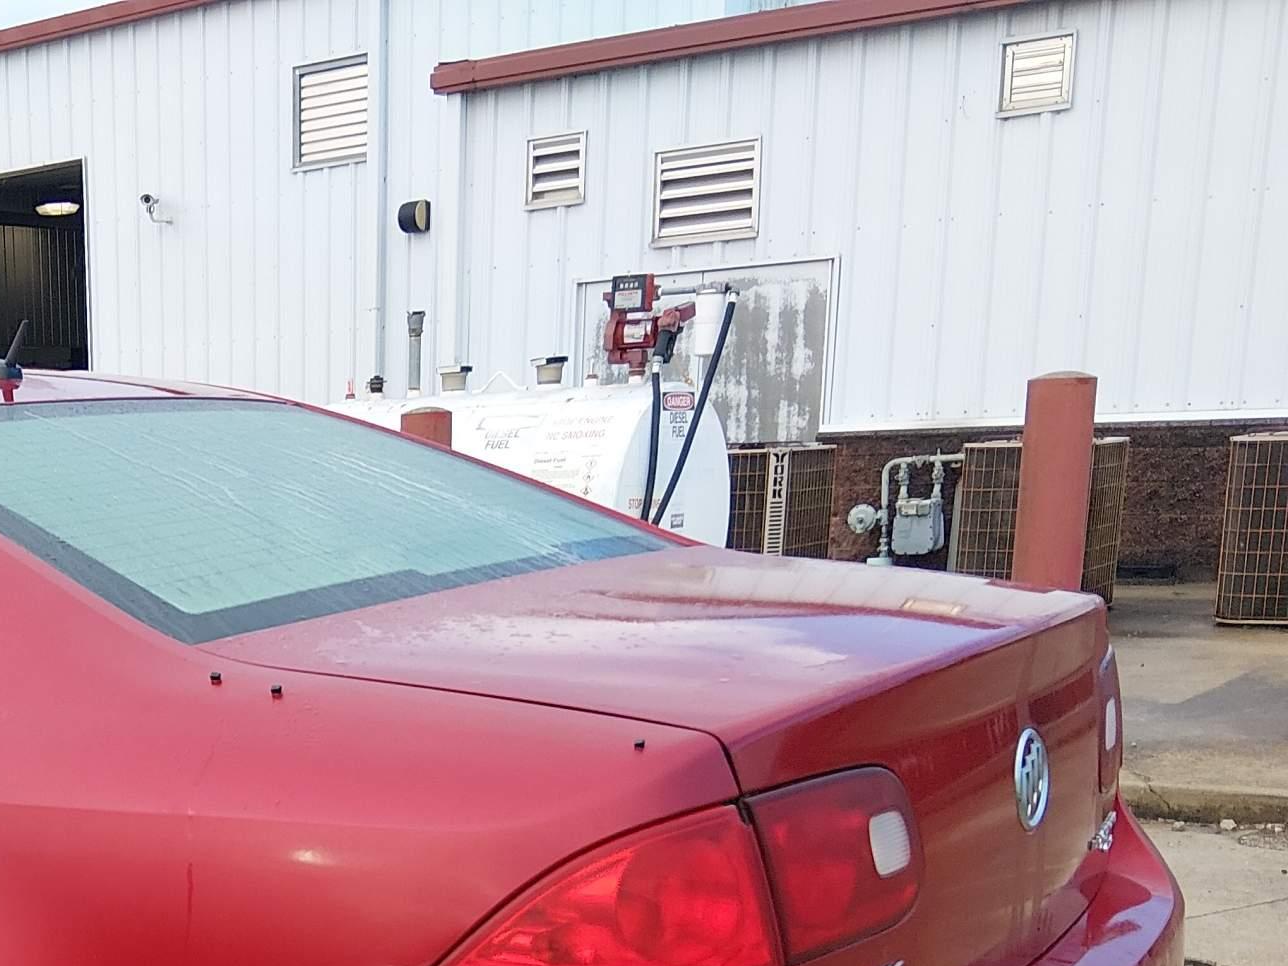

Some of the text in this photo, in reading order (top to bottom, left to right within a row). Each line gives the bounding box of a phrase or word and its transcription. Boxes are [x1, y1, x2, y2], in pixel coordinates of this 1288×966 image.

[666, 396, 691, 406] DANGER
[669, 411, 688, 424] DIESEL
[561, 428, 606, 441] SMOKING
[671, 425, 686, 438] FUEL
[484, 439, 511, 450] FUEL
[772, 452, 788, 499] YORK
[628, 498, 643, 510] STOP
